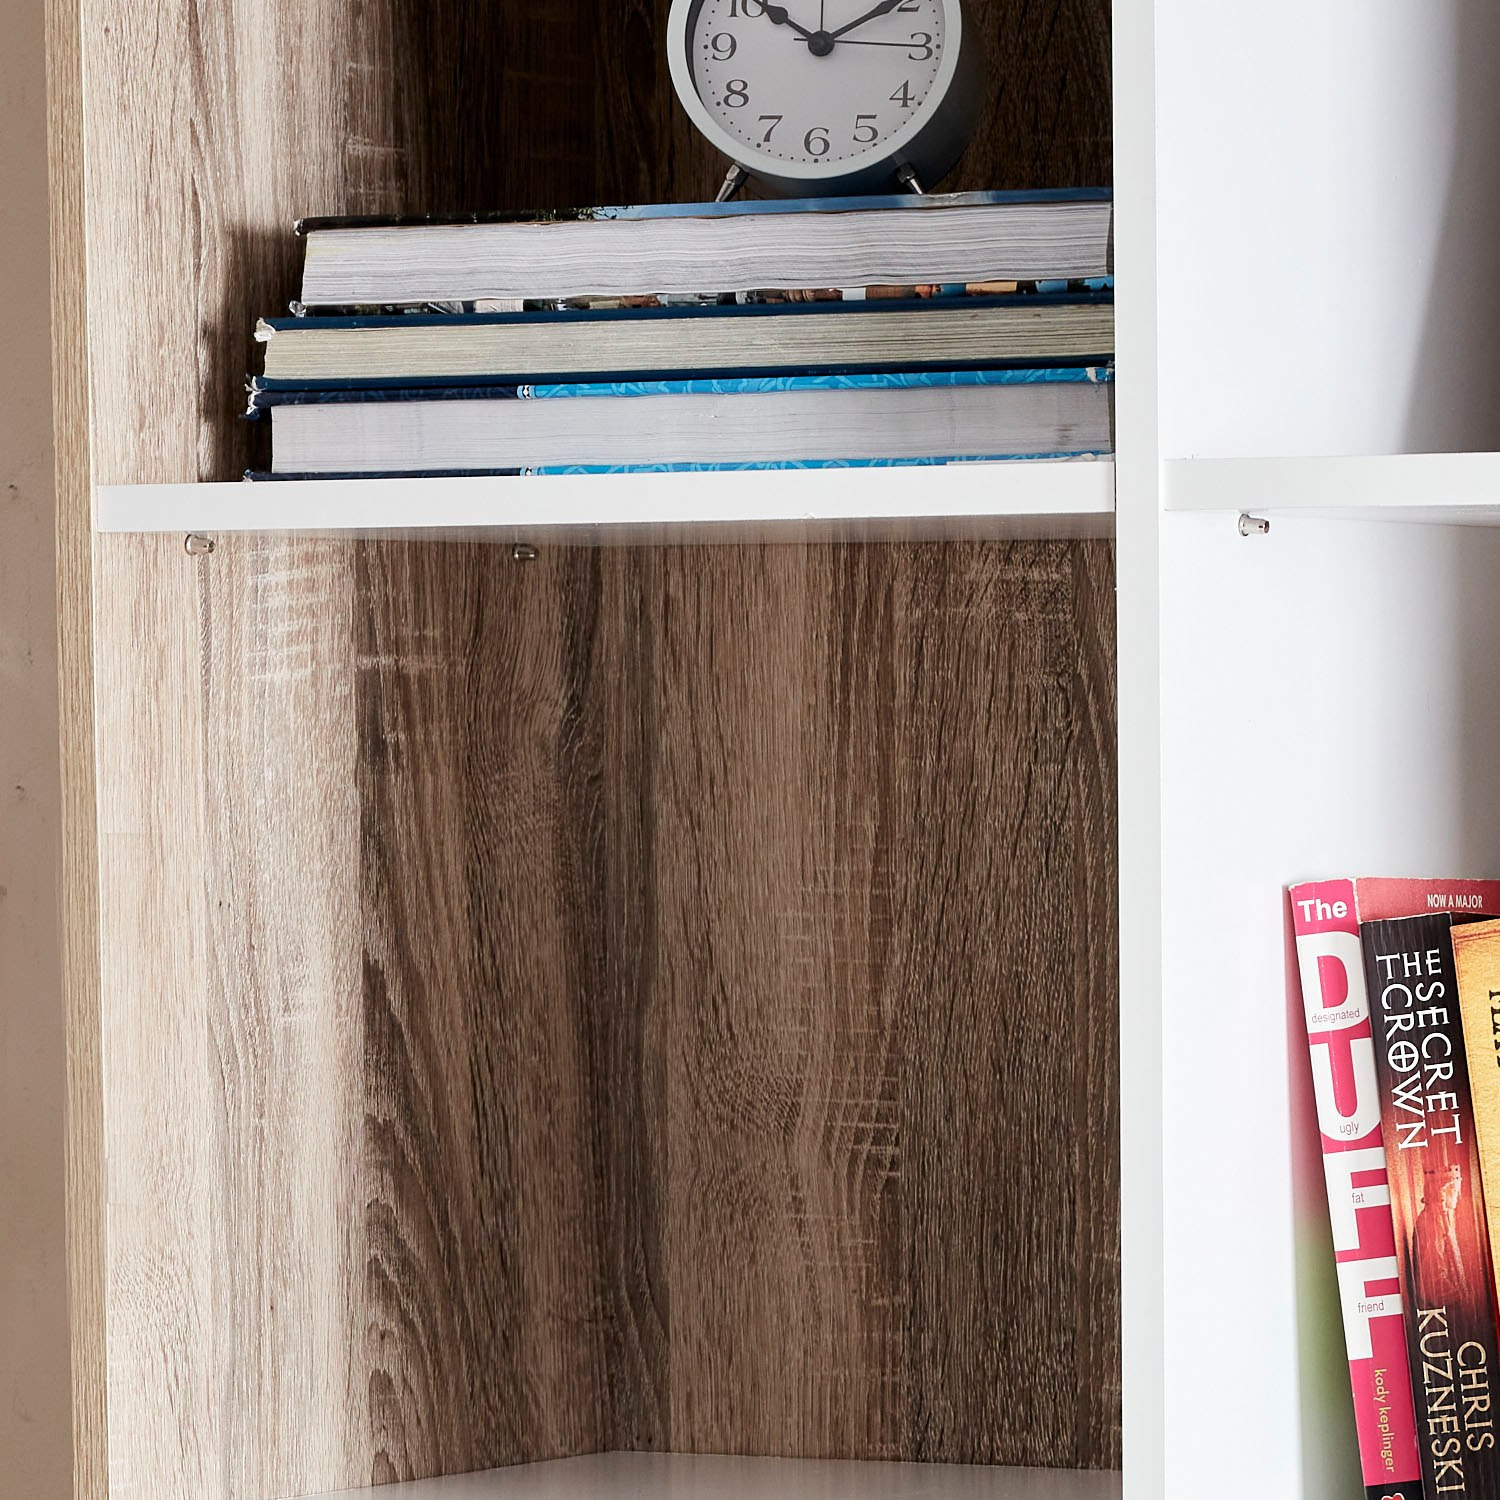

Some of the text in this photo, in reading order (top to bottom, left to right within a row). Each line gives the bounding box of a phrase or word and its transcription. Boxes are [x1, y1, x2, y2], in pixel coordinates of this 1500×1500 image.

[711, 32, 737, 61] 9
[907, 32, 934, 61] 3
[723, 79, 750, 108] 8
[889, 79, 915, 108] 4
[757, 115, 783, 143] 7
[804, 127, 830, 156] 6
[852, 114, 879, 142] 5
[1297, 898, 1348, 923] The
[1427, 893, 1483, 909] NOW A MAJOR
[1376, 948, 1442, 980] THE
[1311, 1008, 1361, 1024] designated
[1381, 983, 1429, 1150] CROWN
[1415, 981, 1463, 1145] SECRET
[1339, 1121, 1360, 1136] ugly
[1351, 1192, 1365, 1204] fat
[1357, 1299, 1385, 1313] friend
[1416, 1305, 1466, 1494] KUZNESKI
[1456, 1341, 1495, 1452] CHRIS
[1374, 1368, 1396, 1473] kody keplinger
